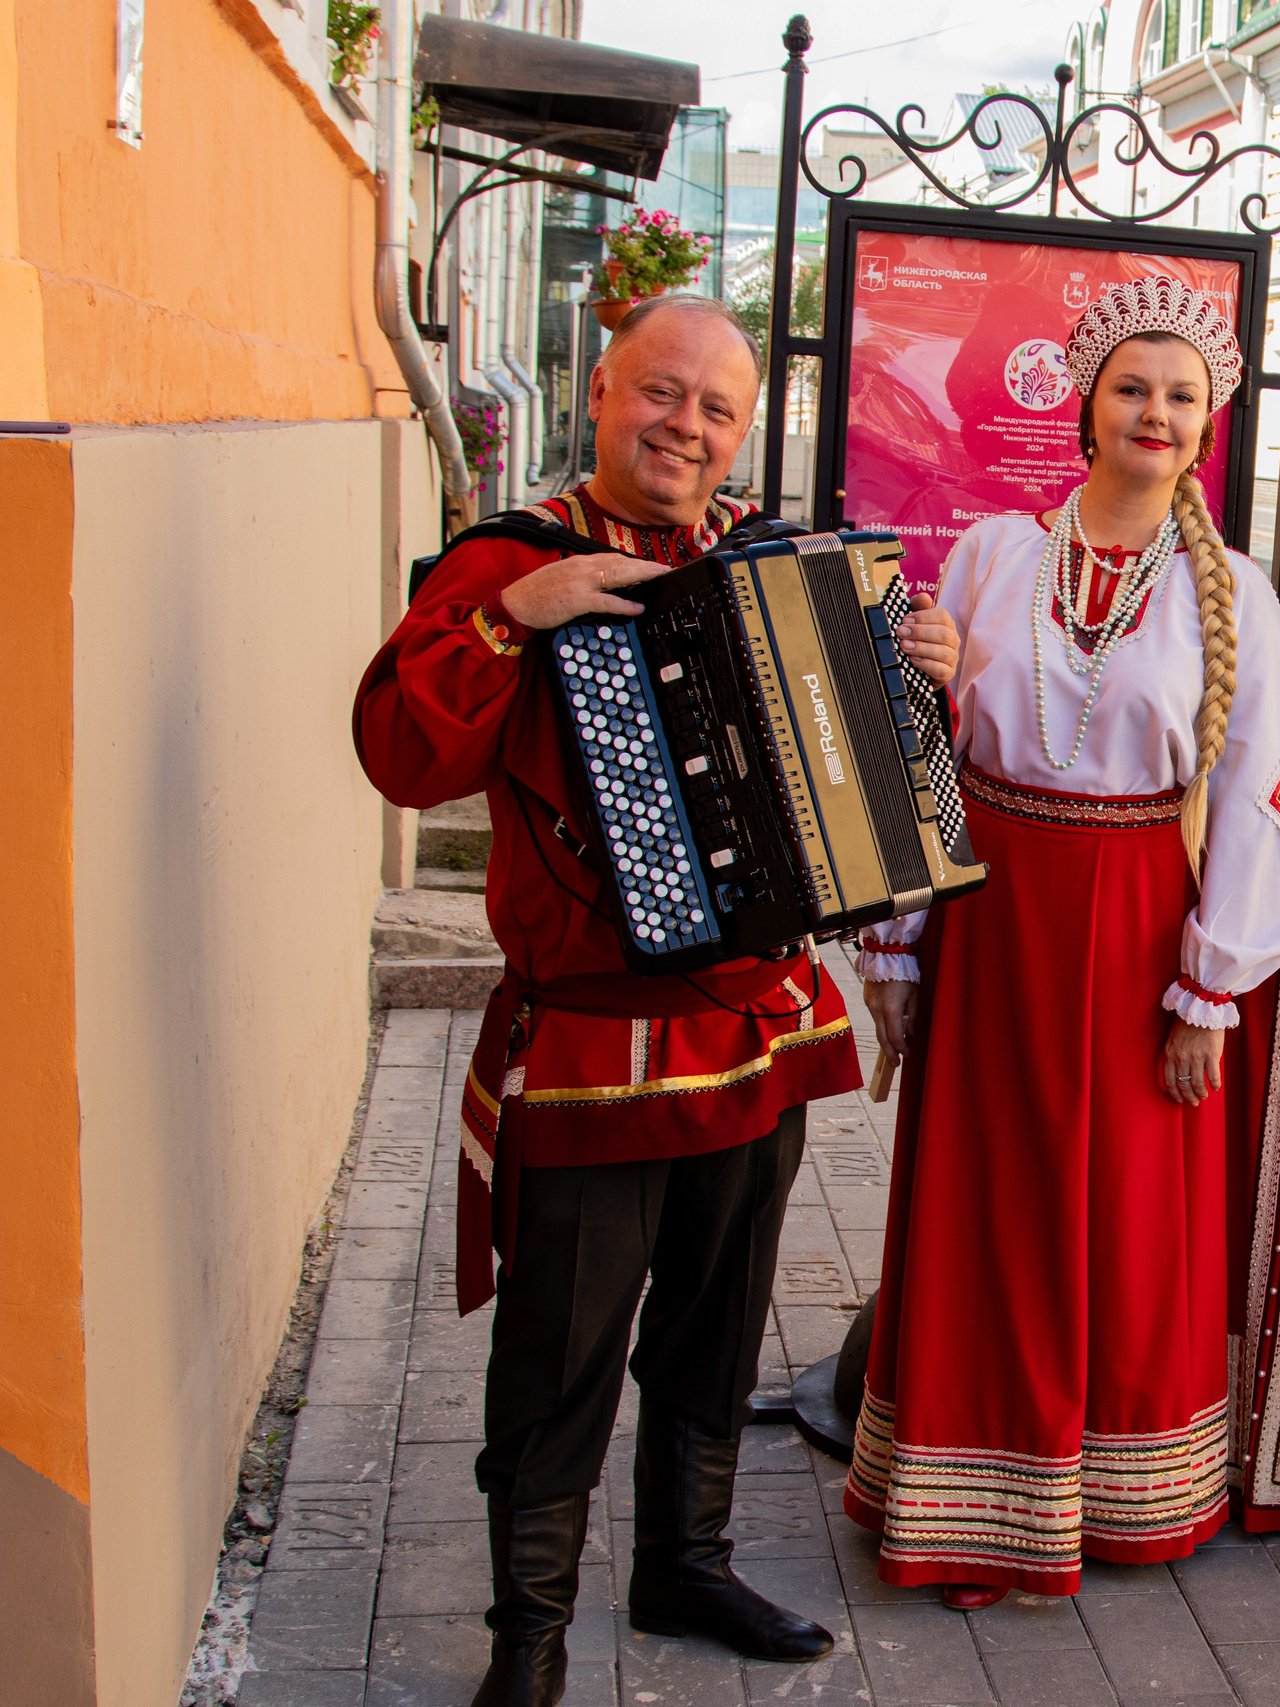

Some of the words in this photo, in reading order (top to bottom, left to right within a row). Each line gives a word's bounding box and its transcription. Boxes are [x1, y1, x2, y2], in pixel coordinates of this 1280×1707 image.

[893, 265, 988, 281] НИЖЕГОРОДСКАЯ
[892, 279, 943, 290] ОБЛАСТЬ
[993, 415, 1055, 426] Международный
[1056, 420, 1079, 428] форум
[976, 423, 1050, 435] «Города-побратимы
[1003, 434, 1032, 443] Нижний
[1033, 436, 1068, 446] Новгород
[1026, 444, 1044, 452] 2024
[1000, 457, 1045, 466] International
[1046, 460, 1068, 468] forum
[986, 464, 1032, 474] «Sister-cities
[1033, 467, 1046, 475] and
[1047, 469, 1081, 477] partners»
[1003, 475, 1028, 484] Nizhny
[1028, 476, 1063, 486] Novgorod
[1023, 485, 1043, 493] 2024
[862, 522, 932, 537] «Нижний
[802, 673, 837, 754] Roland
[733, 741, 747, 773] Roland
